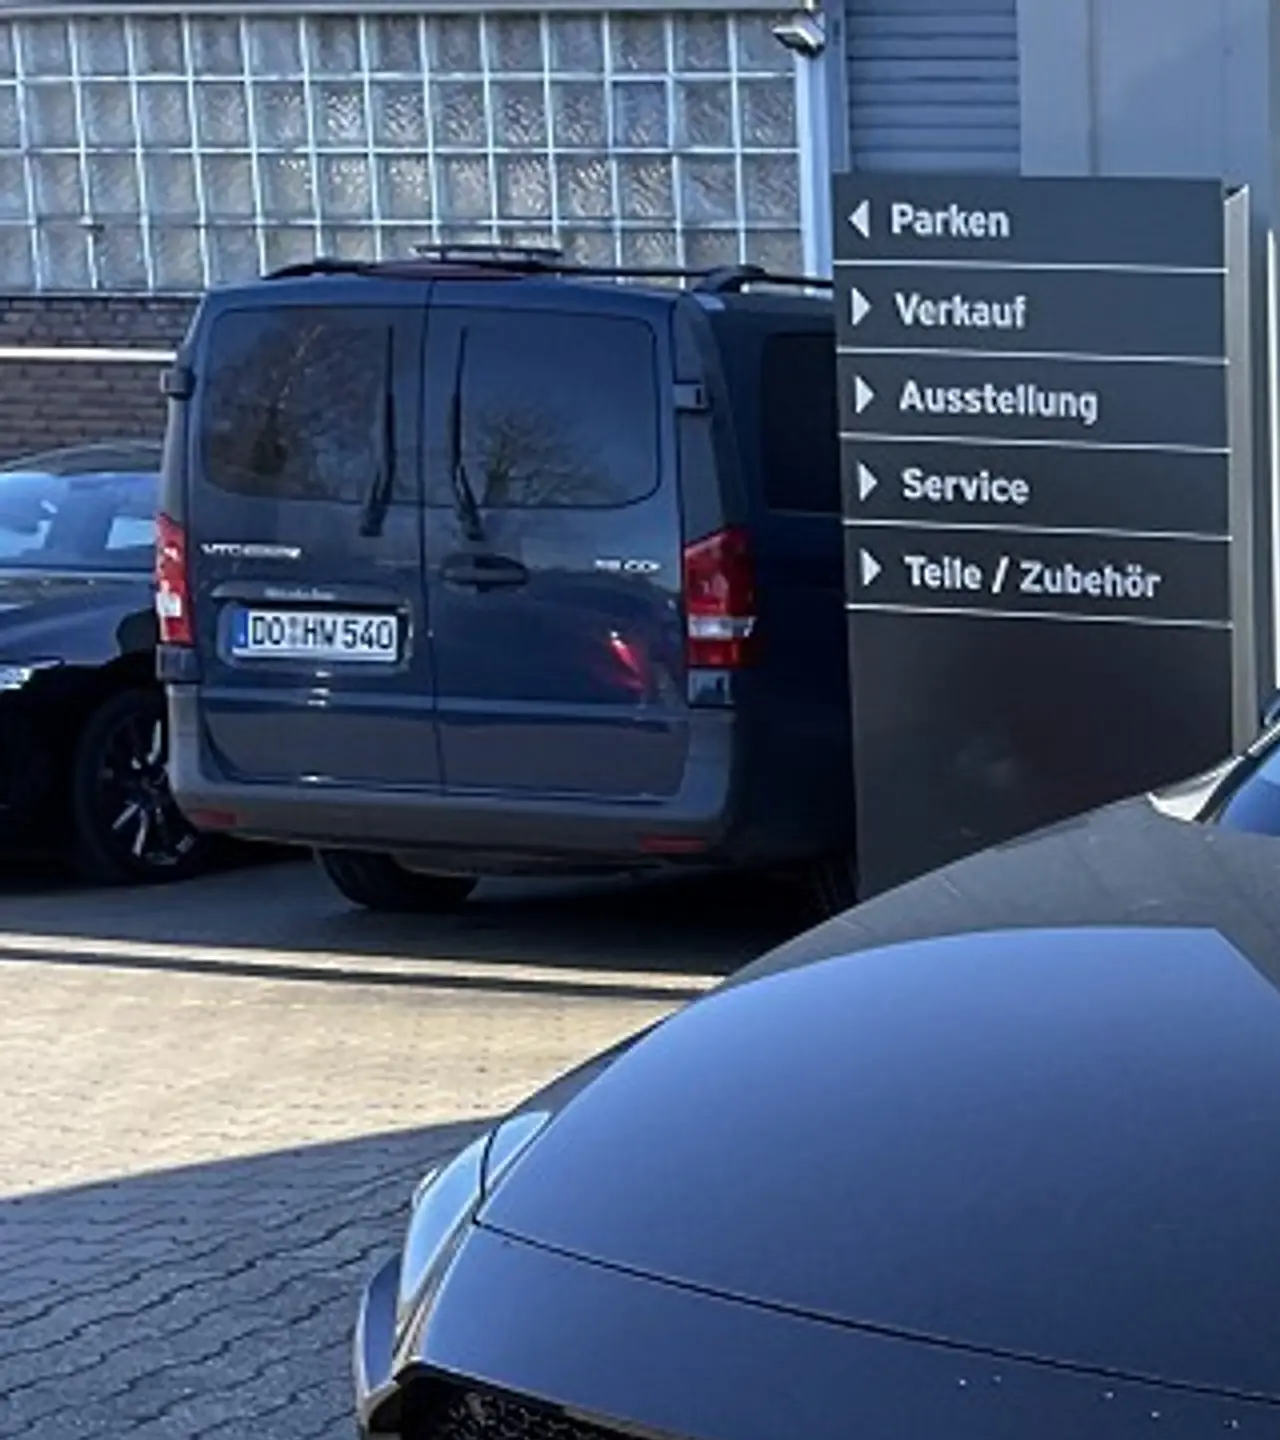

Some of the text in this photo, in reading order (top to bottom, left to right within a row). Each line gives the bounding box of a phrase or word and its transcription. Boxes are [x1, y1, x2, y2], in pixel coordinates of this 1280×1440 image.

[890, 202, 1011, 238] Parken
[895, 292, 1028, 330] Verkauf
[899, 379, 1099, 426] Ausstellung
[900, 467, 1030, 505] Service
[904, 554, 1162, 599] Teile / Zubehör
[251, 615, 286, 646] DO
[341, 619, 394, 650] 540
